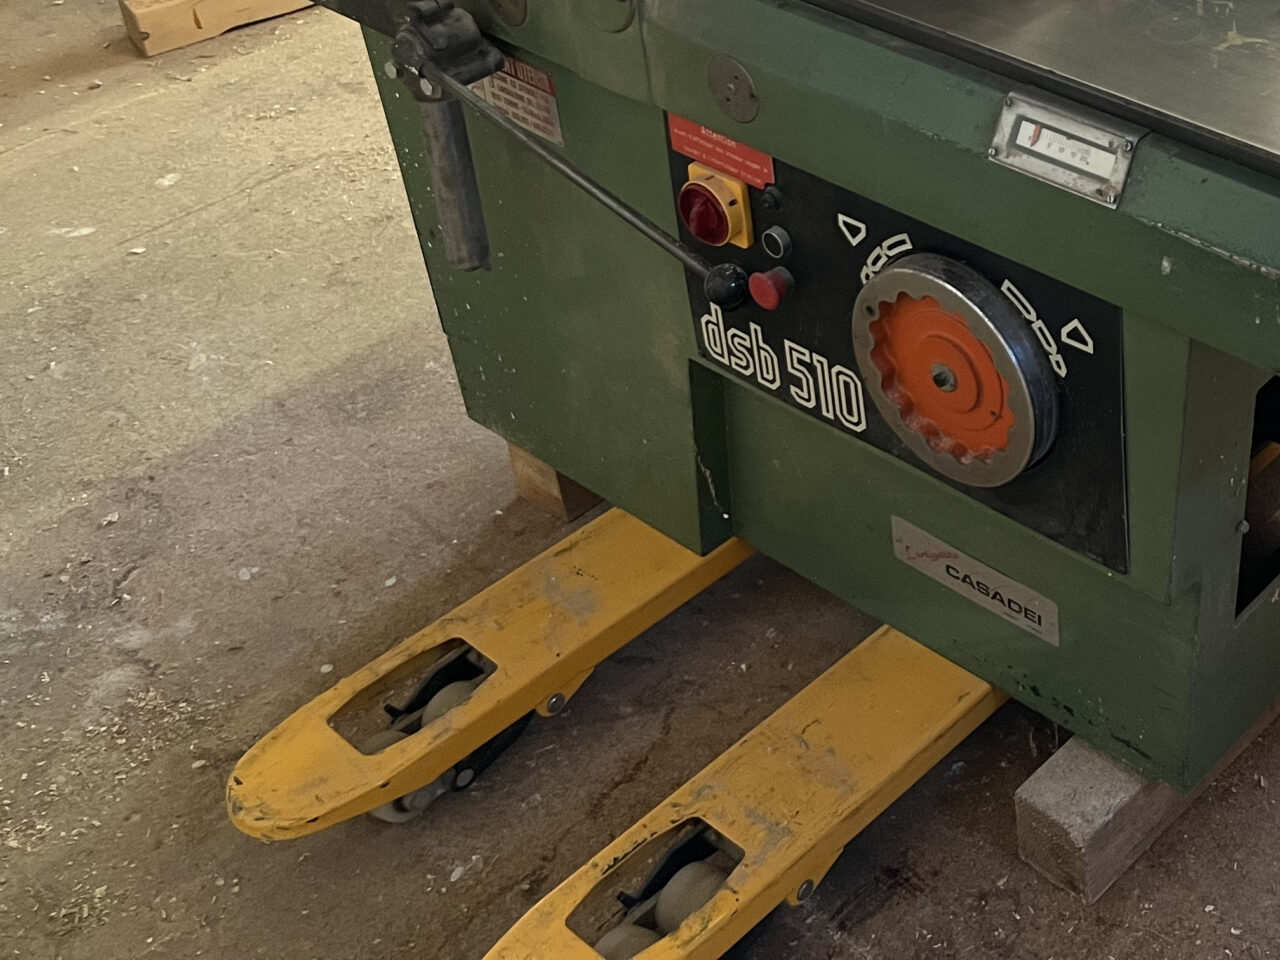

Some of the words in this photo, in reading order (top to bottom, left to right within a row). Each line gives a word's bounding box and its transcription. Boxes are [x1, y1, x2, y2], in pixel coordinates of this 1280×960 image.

[701, 302, 781, 390] dsb
[785, 339, 867, 433] 510
[945, 564, 1042, 627] CASADEI
